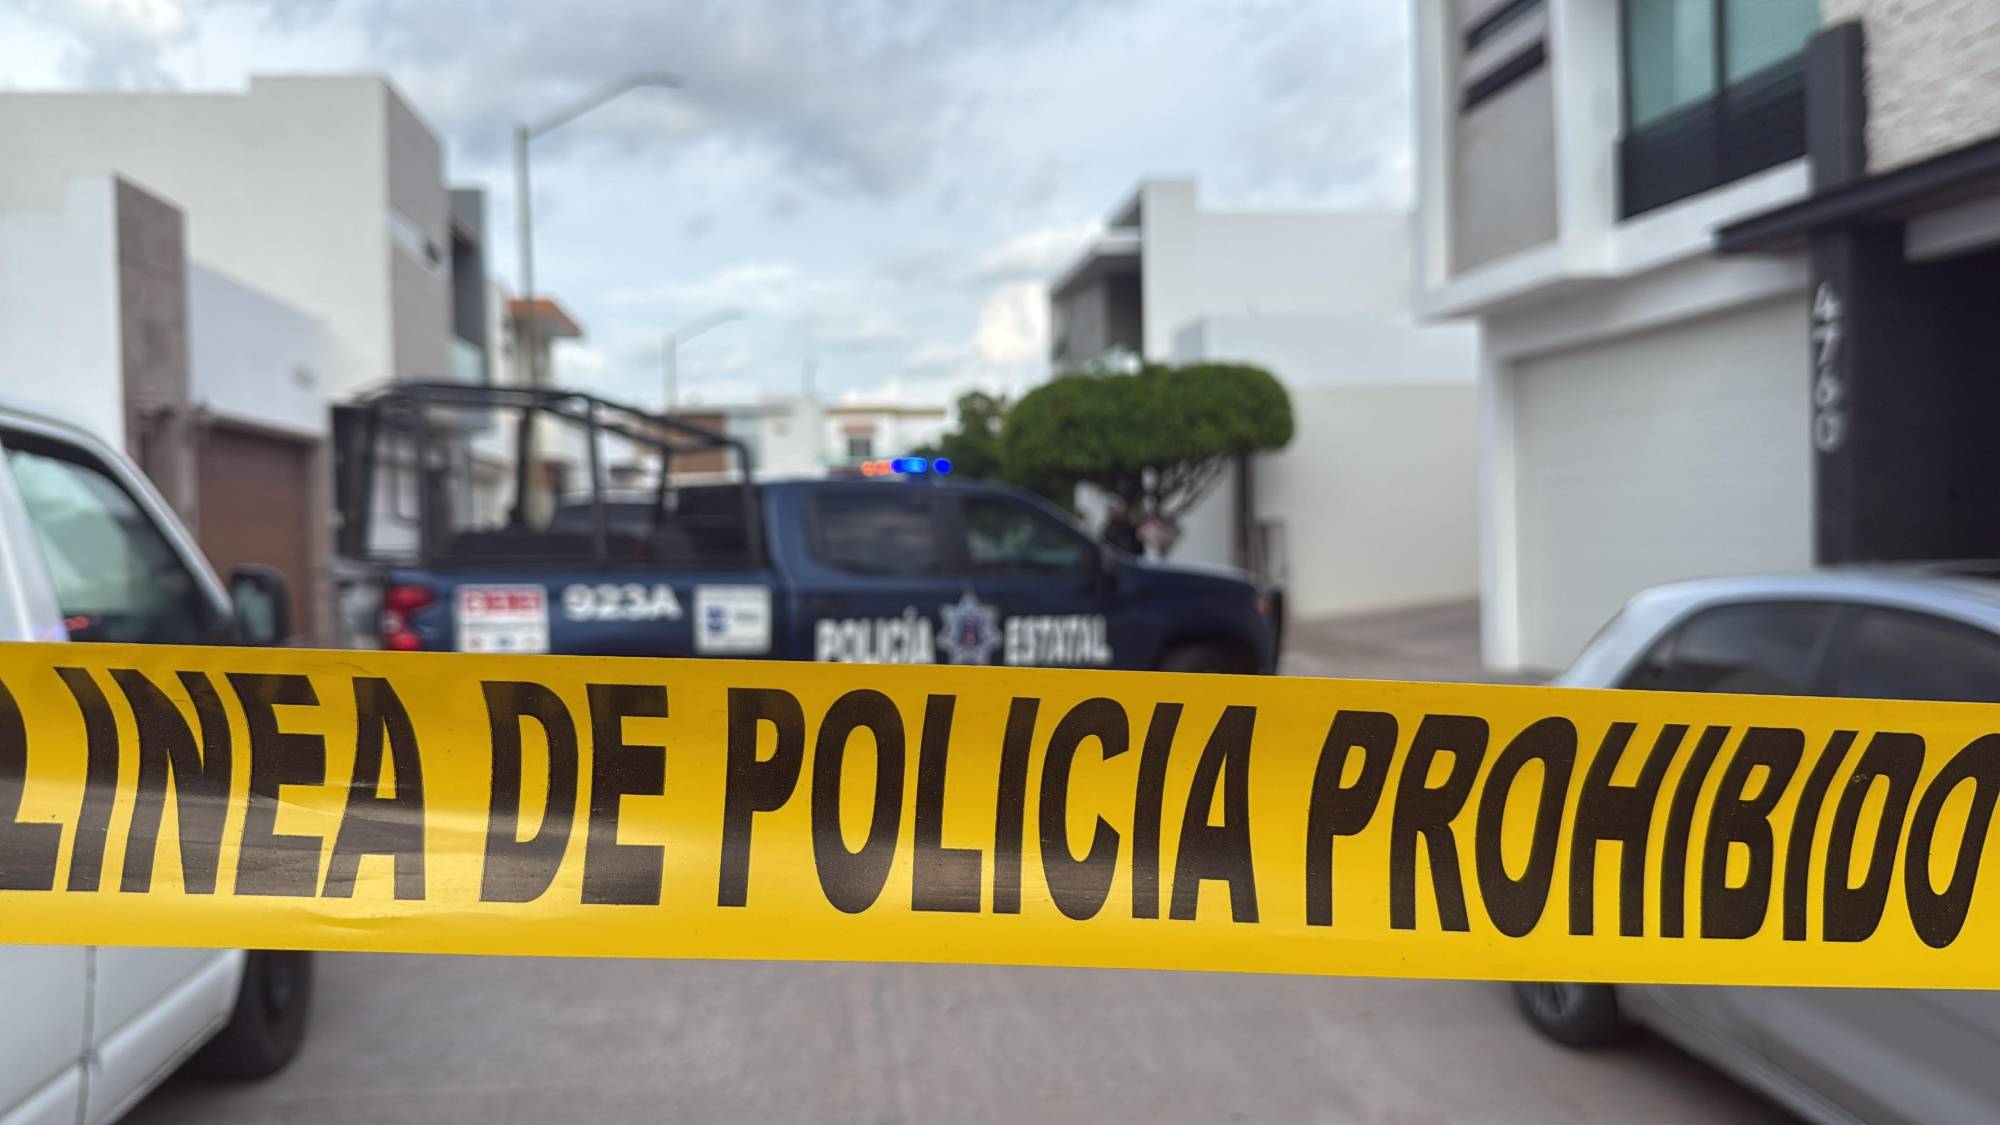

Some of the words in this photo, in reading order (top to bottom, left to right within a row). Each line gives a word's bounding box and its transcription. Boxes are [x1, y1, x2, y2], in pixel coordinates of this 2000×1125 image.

[1812, 281, 1842, 453] 4760
[562, 584, 683, 621] 923A
[1004, 614, 1112, 664] ESTATAL
[0, 666, 426, 901] LINEA
[478, 680, 669, 906] DE
[717, 687, 1260, 923] POLICIA
[1305, 710, 2000, 949] PROHIBIDO
